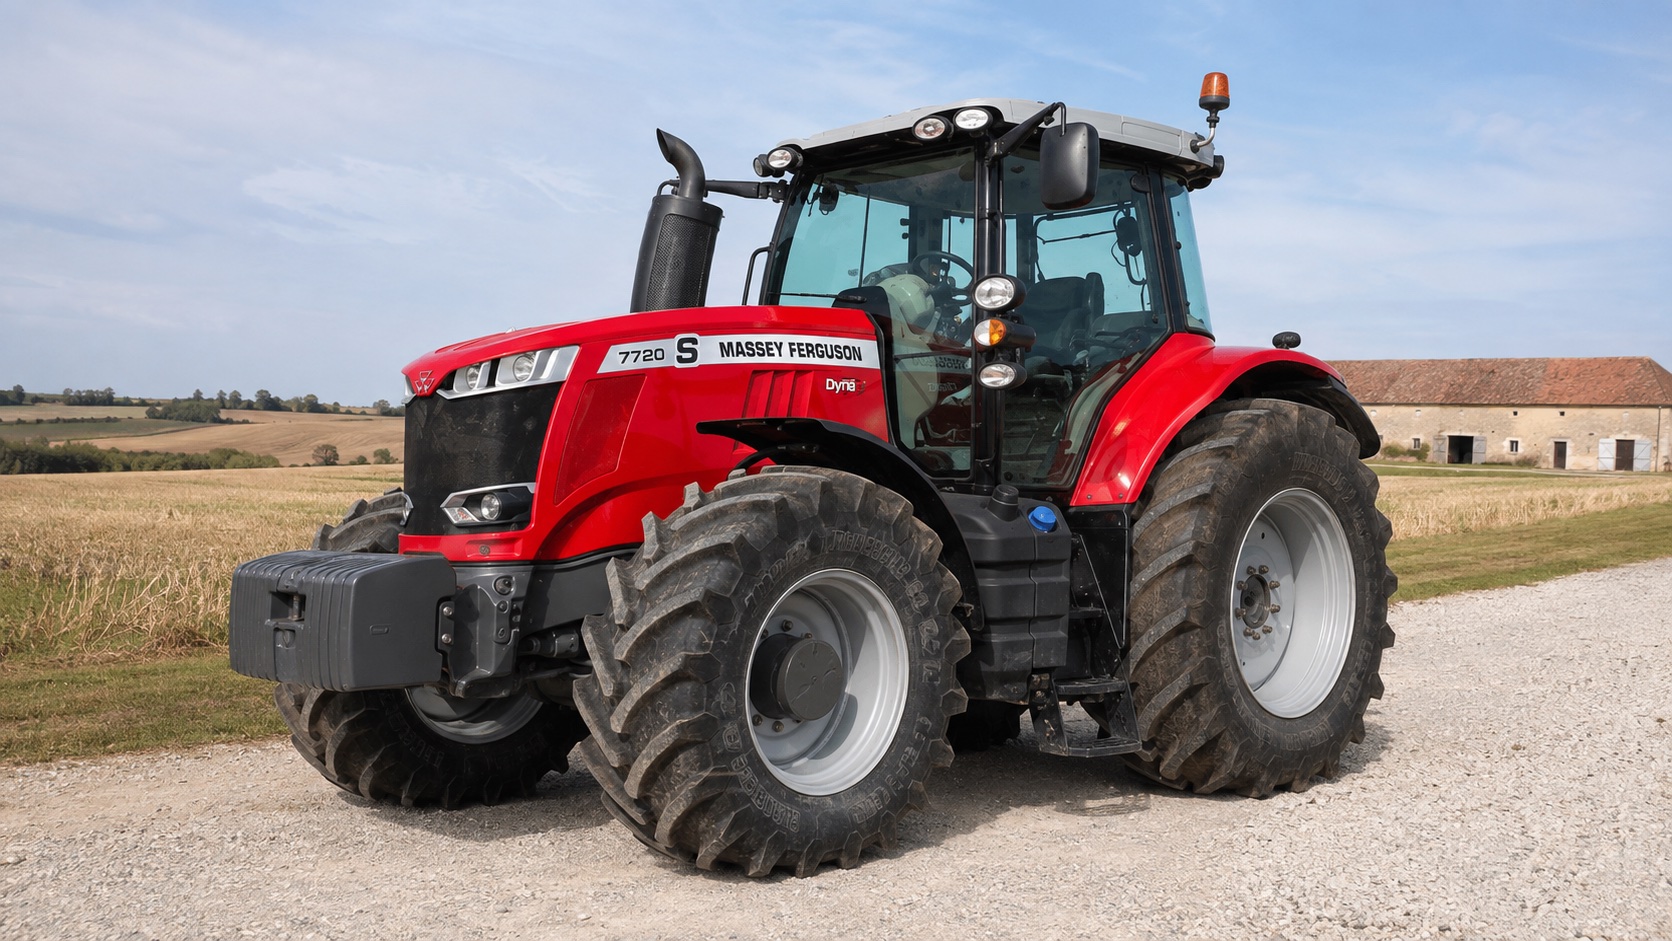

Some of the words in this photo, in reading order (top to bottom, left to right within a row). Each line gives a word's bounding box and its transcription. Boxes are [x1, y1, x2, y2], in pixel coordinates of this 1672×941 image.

[618, 348, 665, 364] 7720
[676, 337, 699, 364] S
[718, 341, 784, 358] MASSEY
[787, 342, 863, 361] FERGUSON
